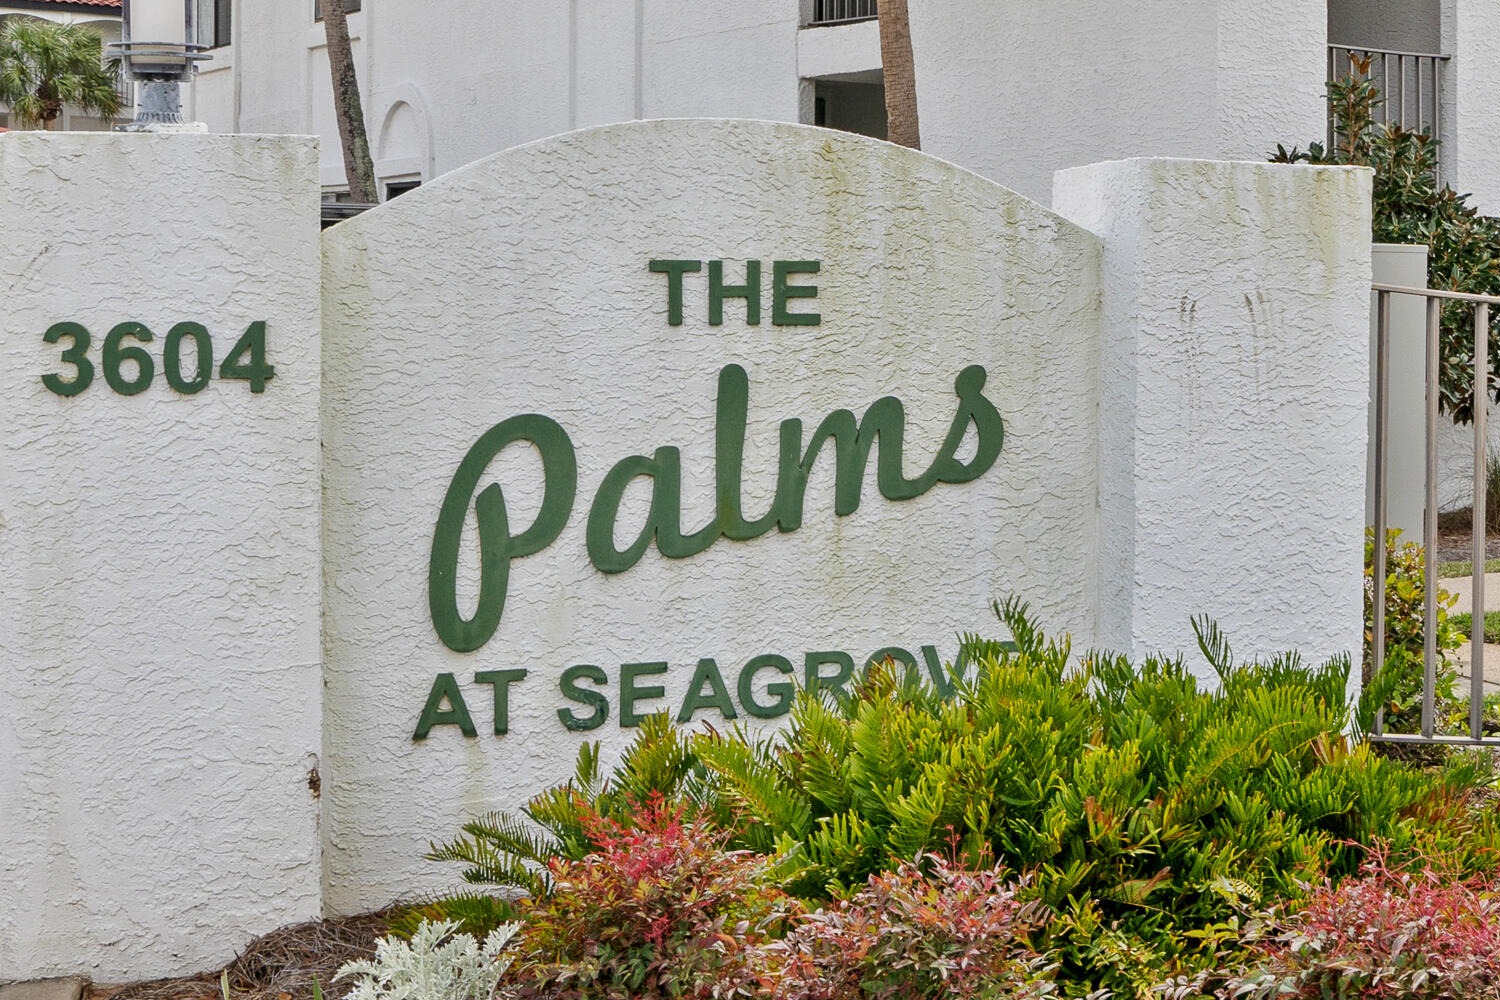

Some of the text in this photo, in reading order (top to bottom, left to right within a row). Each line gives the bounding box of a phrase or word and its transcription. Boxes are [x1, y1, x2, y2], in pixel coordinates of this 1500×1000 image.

[648, 259, 822, 326] THE
[41, 320, 275, 397] 3604
[428, 363, 1004, 653] Palms
[412, 640, 1020, 741] AT SEAGROV
